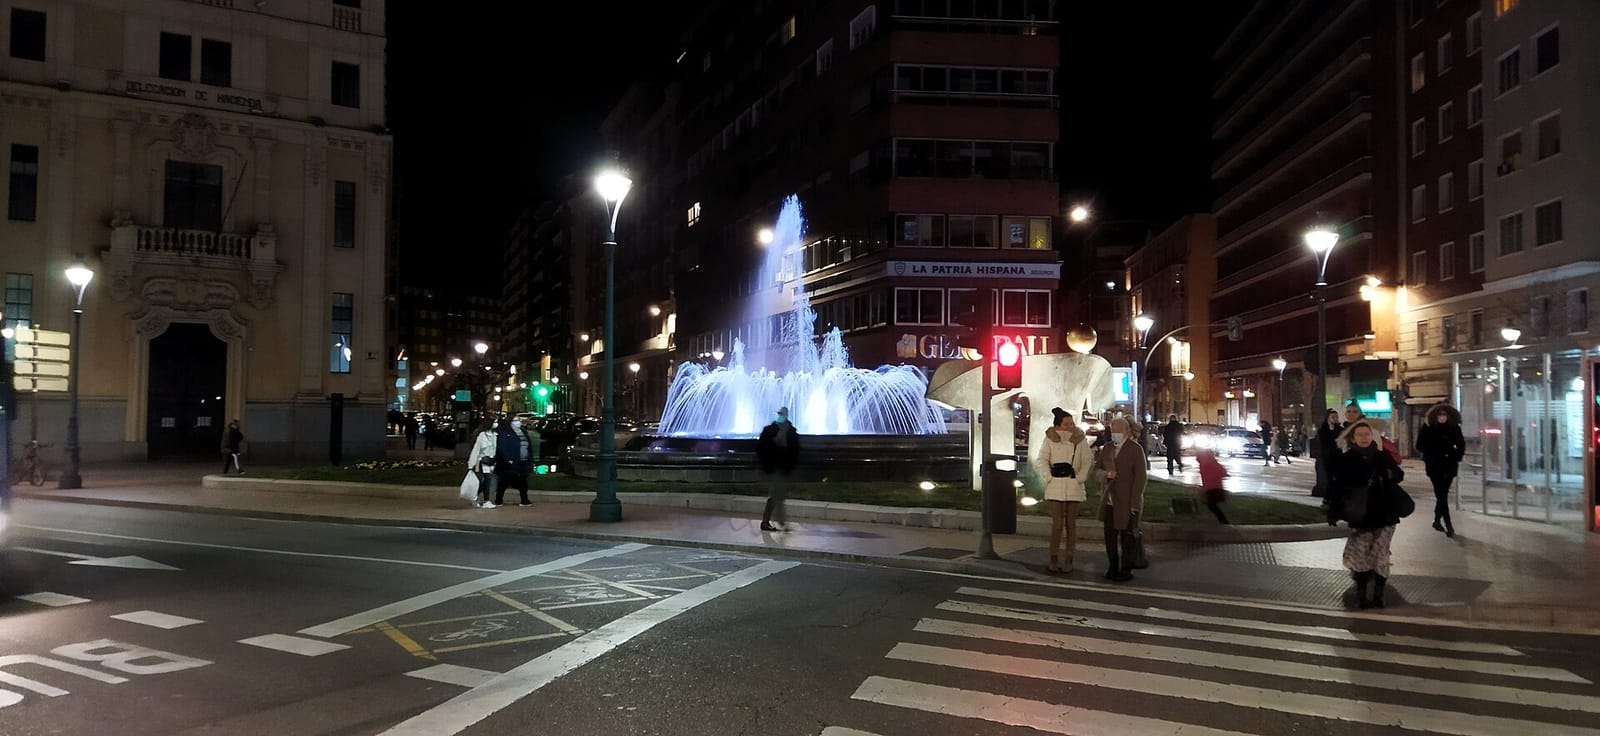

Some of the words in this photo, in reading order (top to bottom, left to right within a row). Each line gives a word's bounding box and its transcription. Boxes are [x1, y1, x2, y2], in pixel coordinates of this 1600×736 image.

[194, 90, 208, 101] DE
[912, 264, 927, 274] LA
[932, 265, 972, 275] PATRIA
[976, 266, 1025, 275] HISPANA
[0, 638, 215, 709] BU
